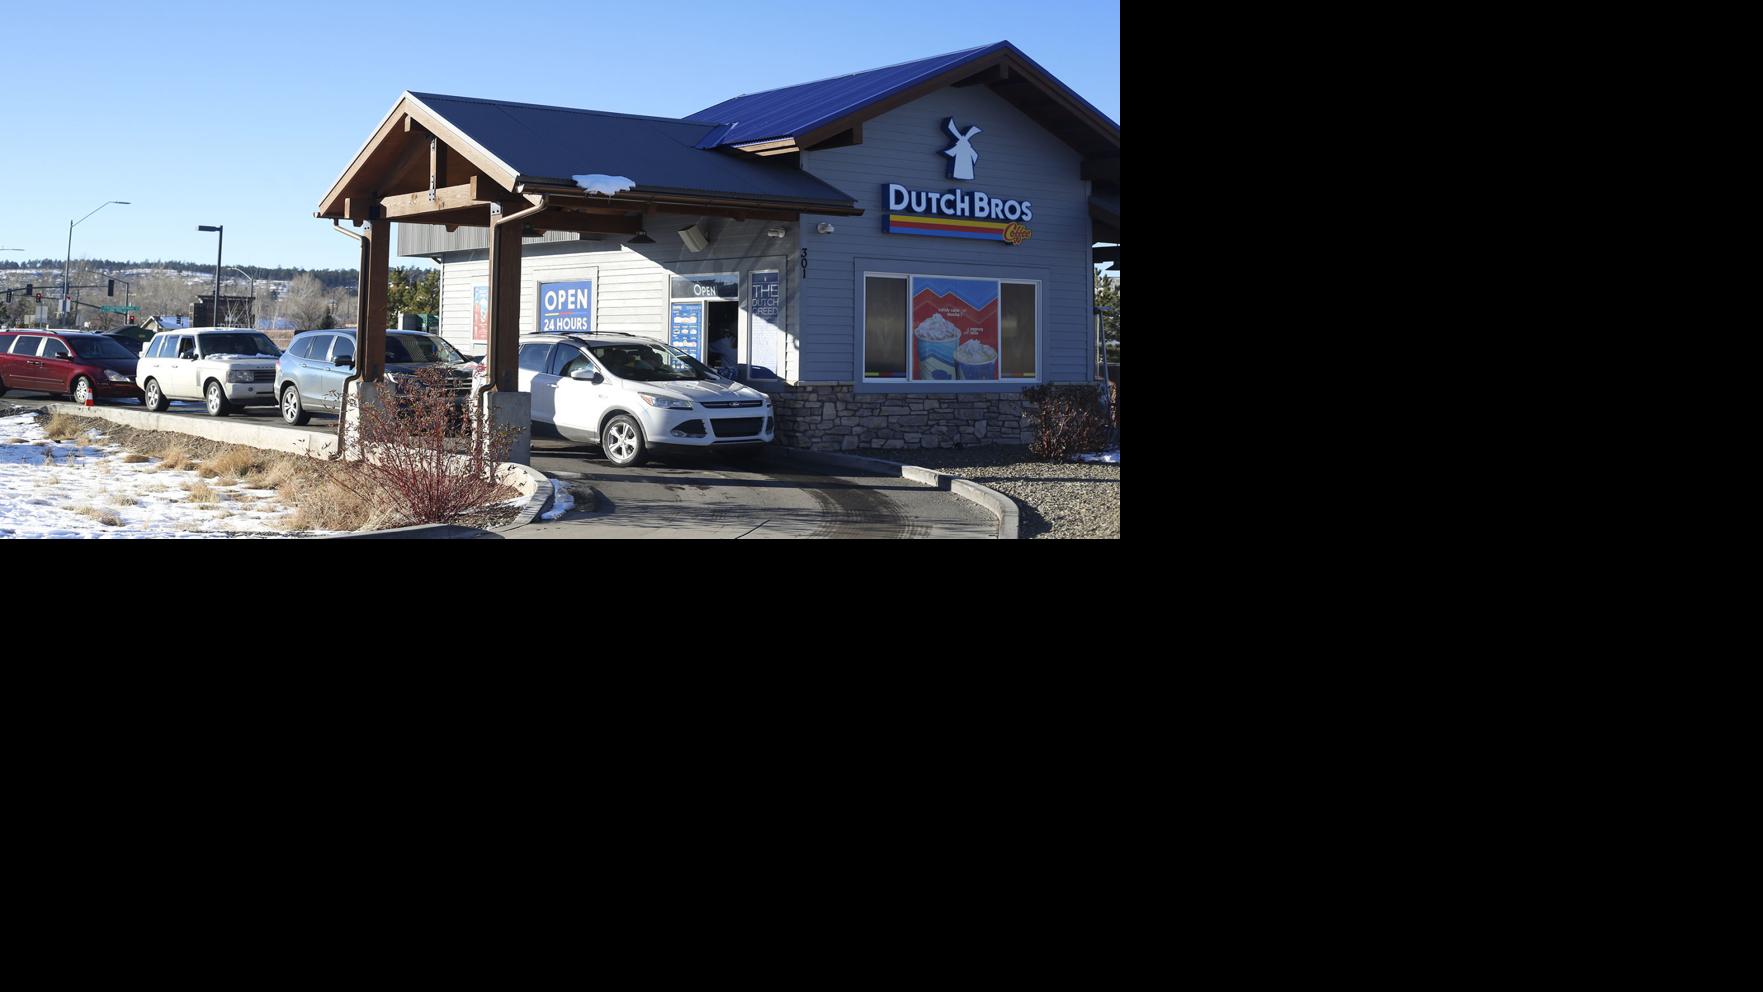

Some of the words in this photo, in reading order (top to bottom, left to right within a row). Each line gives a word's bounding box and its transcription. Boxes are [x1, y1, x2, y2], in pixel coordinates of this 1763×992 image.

[889, 183, 970, 217] DUTCH
[974, 191, 1033, 222] BROS
[1003, 222, 1032, 245] Coffee
[800, 247, 808, 279] 301
[544, 288, 588, 311] OPEN
[751, 298, 779, 307] DUTCH
[752, 284, 779, 298] THE
[543, 318, 555, 331] 24
[556, 317, 588, 330] HOURS
